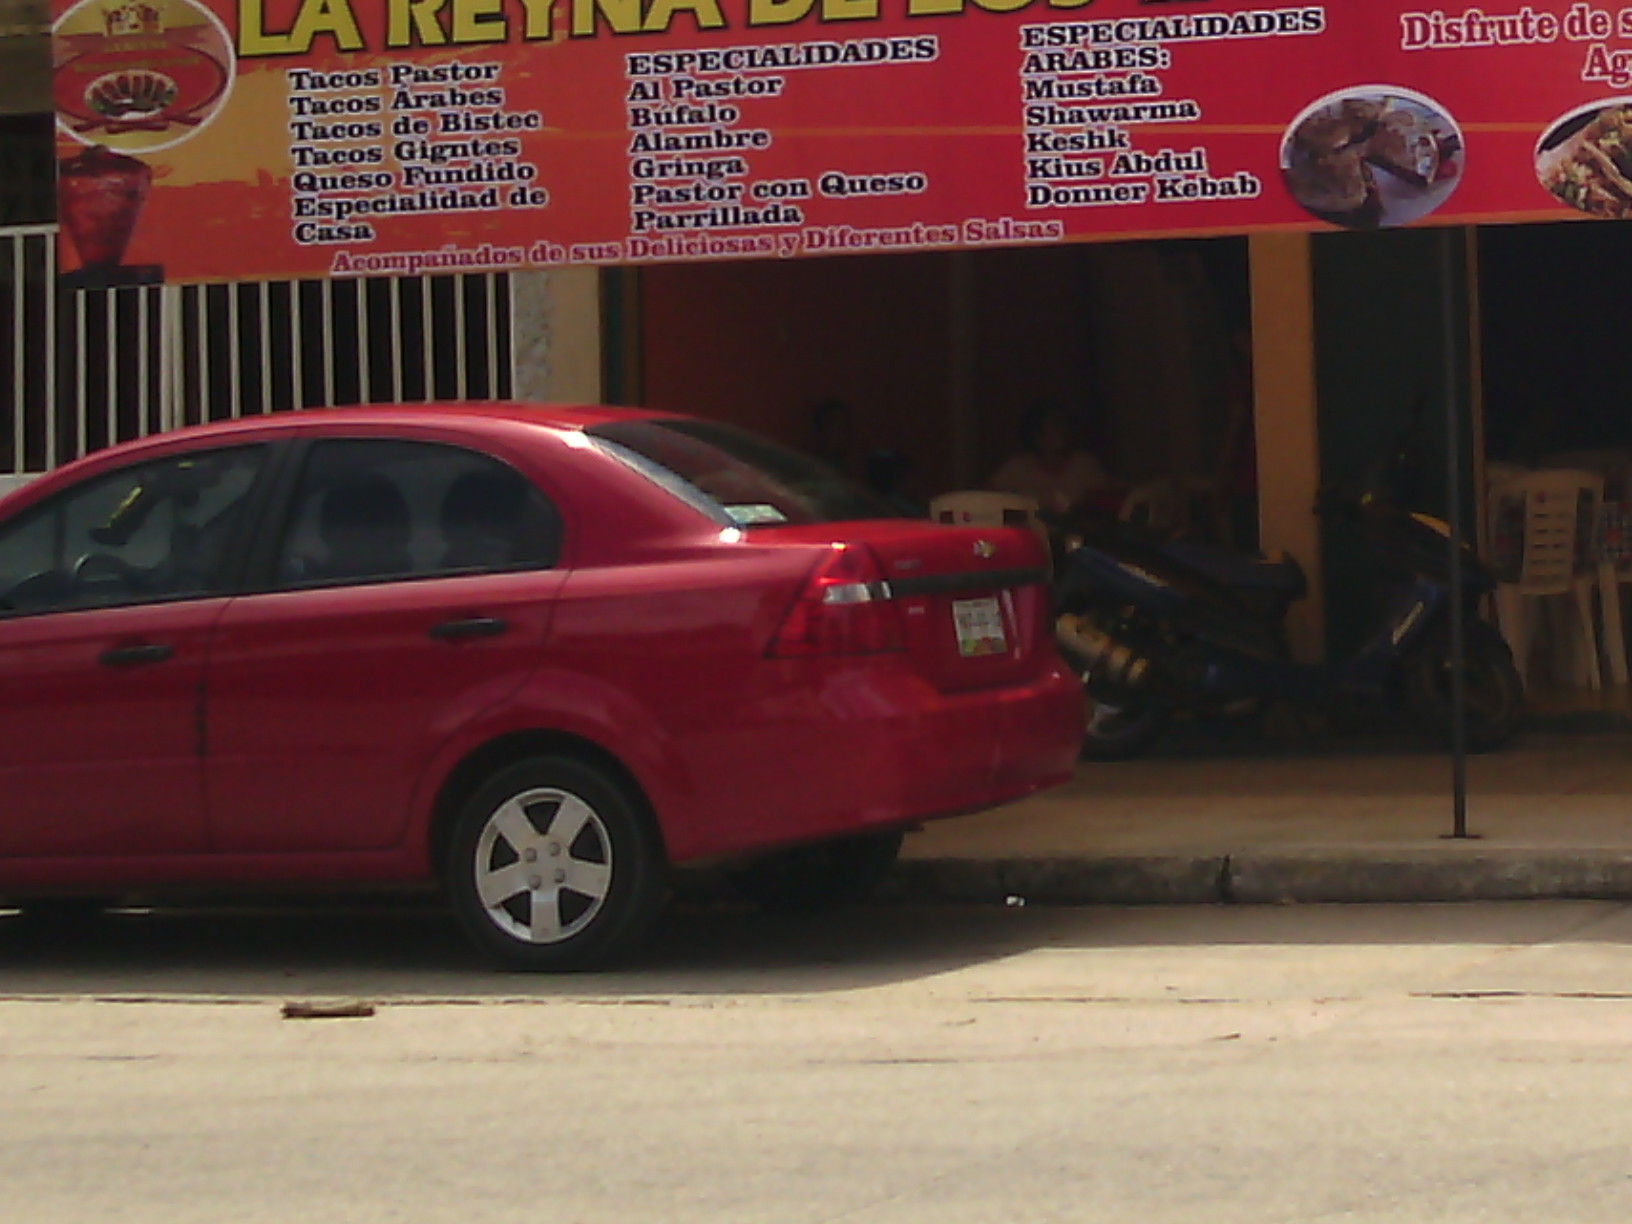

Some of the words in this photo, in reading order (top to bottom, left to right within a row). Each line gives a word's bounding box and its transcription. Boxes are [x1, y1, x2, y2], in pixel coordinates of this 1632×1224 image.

[1022, 8, 1323, 48] ESPECIALIDADES
[1401, 7, 1557, 49] Disfrute
[1566, 3, 1609, 39] de
[628, 38, 937, 75] ESPECIALIDADES
[1024, 47, 1170, 74] ARABES:
[289, 69, 380, 90] Tacos
[390, 63, 499, 85] Pastor
[629, 81, 661, 101] Al
[672, 76, 782, 99] Pastor
[1025, 75, 1160, 101] Mustafa
[289, 95, 381, 116] Tacos
[630, 104, 738, 127] Búfalo
[1026, 100, 1198, 127] Shawarma
[291, 120, 382, 141] Tacos
[393, 116, 429, 135] de
[440, 111, 540, 133] Bistec
[291, 146, 383, 167] Tacos
[394, 138, 519, 164] Gigntes
[630, 128, 769, 153] Alambre
[1026, 129, 1128, 153] Keshk
[293, 171, 393, 192] Queso
[403, 163, 536, 186] Fundido
[632, 155, 744, 180] Gringa
[1027, 158, 1102, 180] Kius
[1111, 149, 1206, 176] Abdul
[633, 181, 742, 205] Pastor
[753, 179, 809, 199] con
[819, 172, 926, 196] Queso
[1028, 183, 1147, 207] Donner
[1156, 174, 1259, 200] Kebab
[294, 188, 499, 221] Especialidad
[510, 187, 547, 206] de
[634, 203, 802, 231] Parrillada
[295, 222, 373, 243] Casa
[333, 244, 523, 274] Acompañados
[532, 242, 563, 263] de
[572, 242, 620, 262] sus
[629, 232, 774, 259] Deliciosas
[779, 236, 798, 257] y
[804, 223, 956, 251] Diferentes
[964, 218, 1063, 242] Salsas
